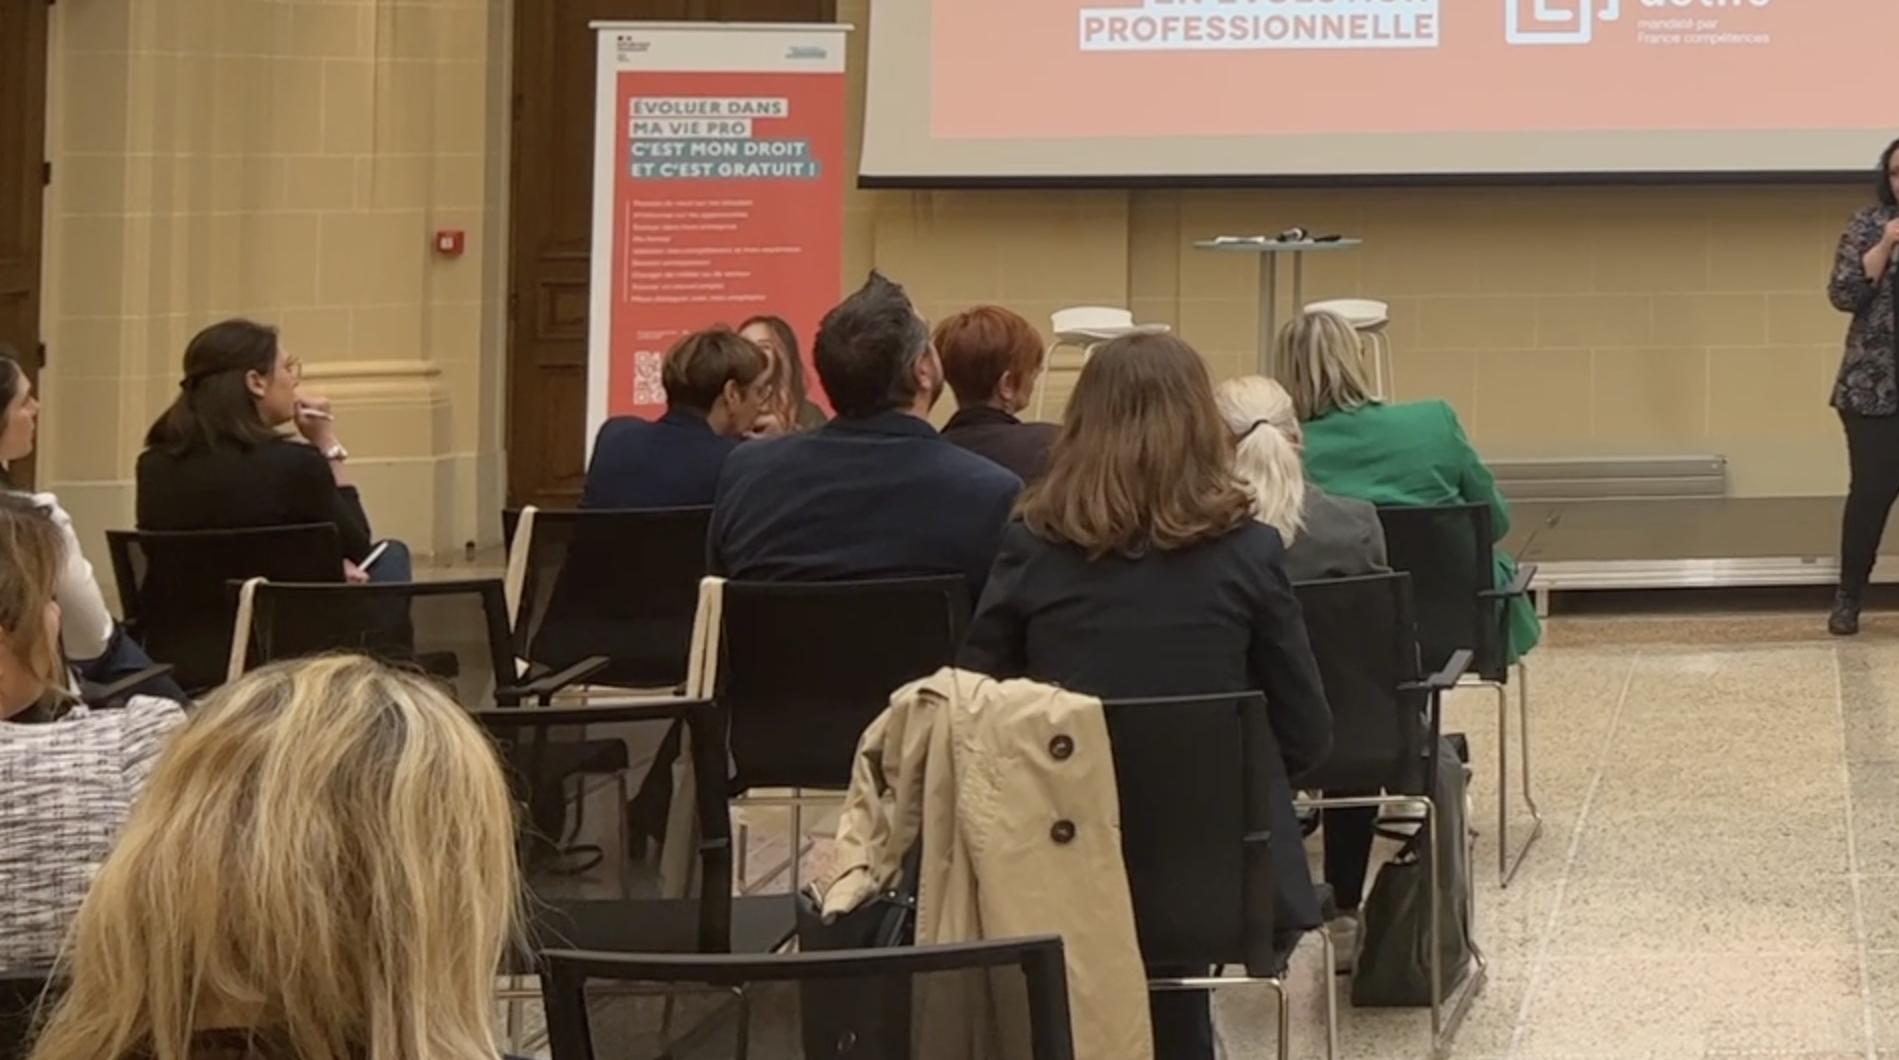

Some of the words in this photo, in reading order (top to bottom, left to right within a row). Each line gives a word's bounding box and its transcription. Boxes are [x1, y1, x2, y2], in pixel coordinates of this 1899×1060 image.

[1084, 14, 1434, 42] PROFESSIONNELLE
[1697, 19, 1719, 31] par
[1637, 32, 1681, 44] France
[633, 98, 721, 115] ÉVOLUER
[728, 101, 782, 115] DANS
[633, 122, 663, 135] MA
[670, 122, 700, 135] VIE
[708, 122, 746, 135] PRO
[631, 142, 685, 157] C'EST
[690, 141, 738, 157] MON
[744, 141, 805, 157] DROIT
[631, 163, 655, 177] ET
[659, 163, 713, 177] C'EST
[717, 163, 804, 177] GRATUIT
[809, 163, 816, 177] !
